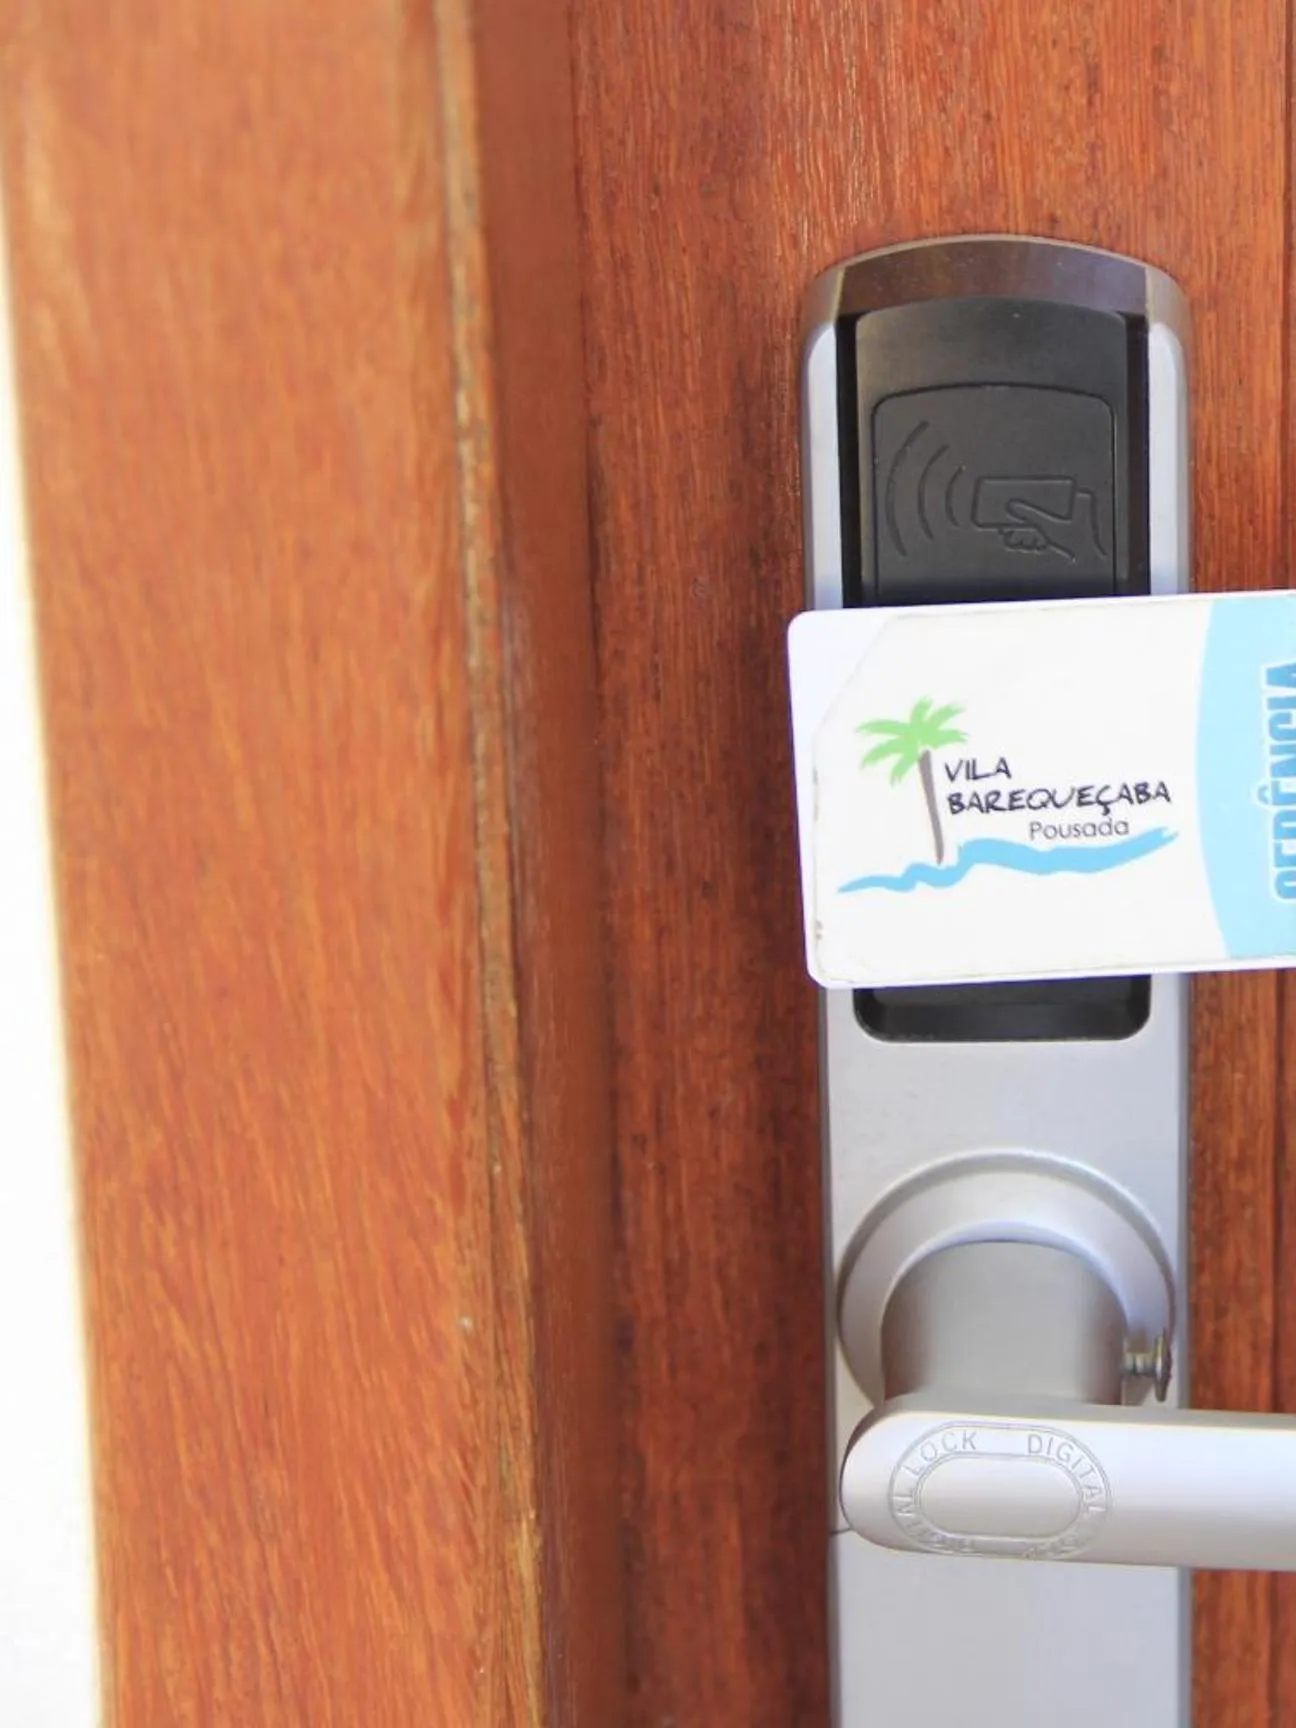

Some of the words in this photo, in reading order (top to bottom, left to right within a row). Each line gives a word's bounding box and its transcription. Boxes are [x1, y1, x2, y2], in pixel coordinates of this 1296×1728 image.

[945, 757, 1012, 782] VILA
[947, 781, 1171, 816] BAREQUEÇABA
[1028, 818, 1130, 841] Pousada
[900, 1430, 977, 1477] LOCK
[1027, 1433, 1107, 1523] DIGITAL
